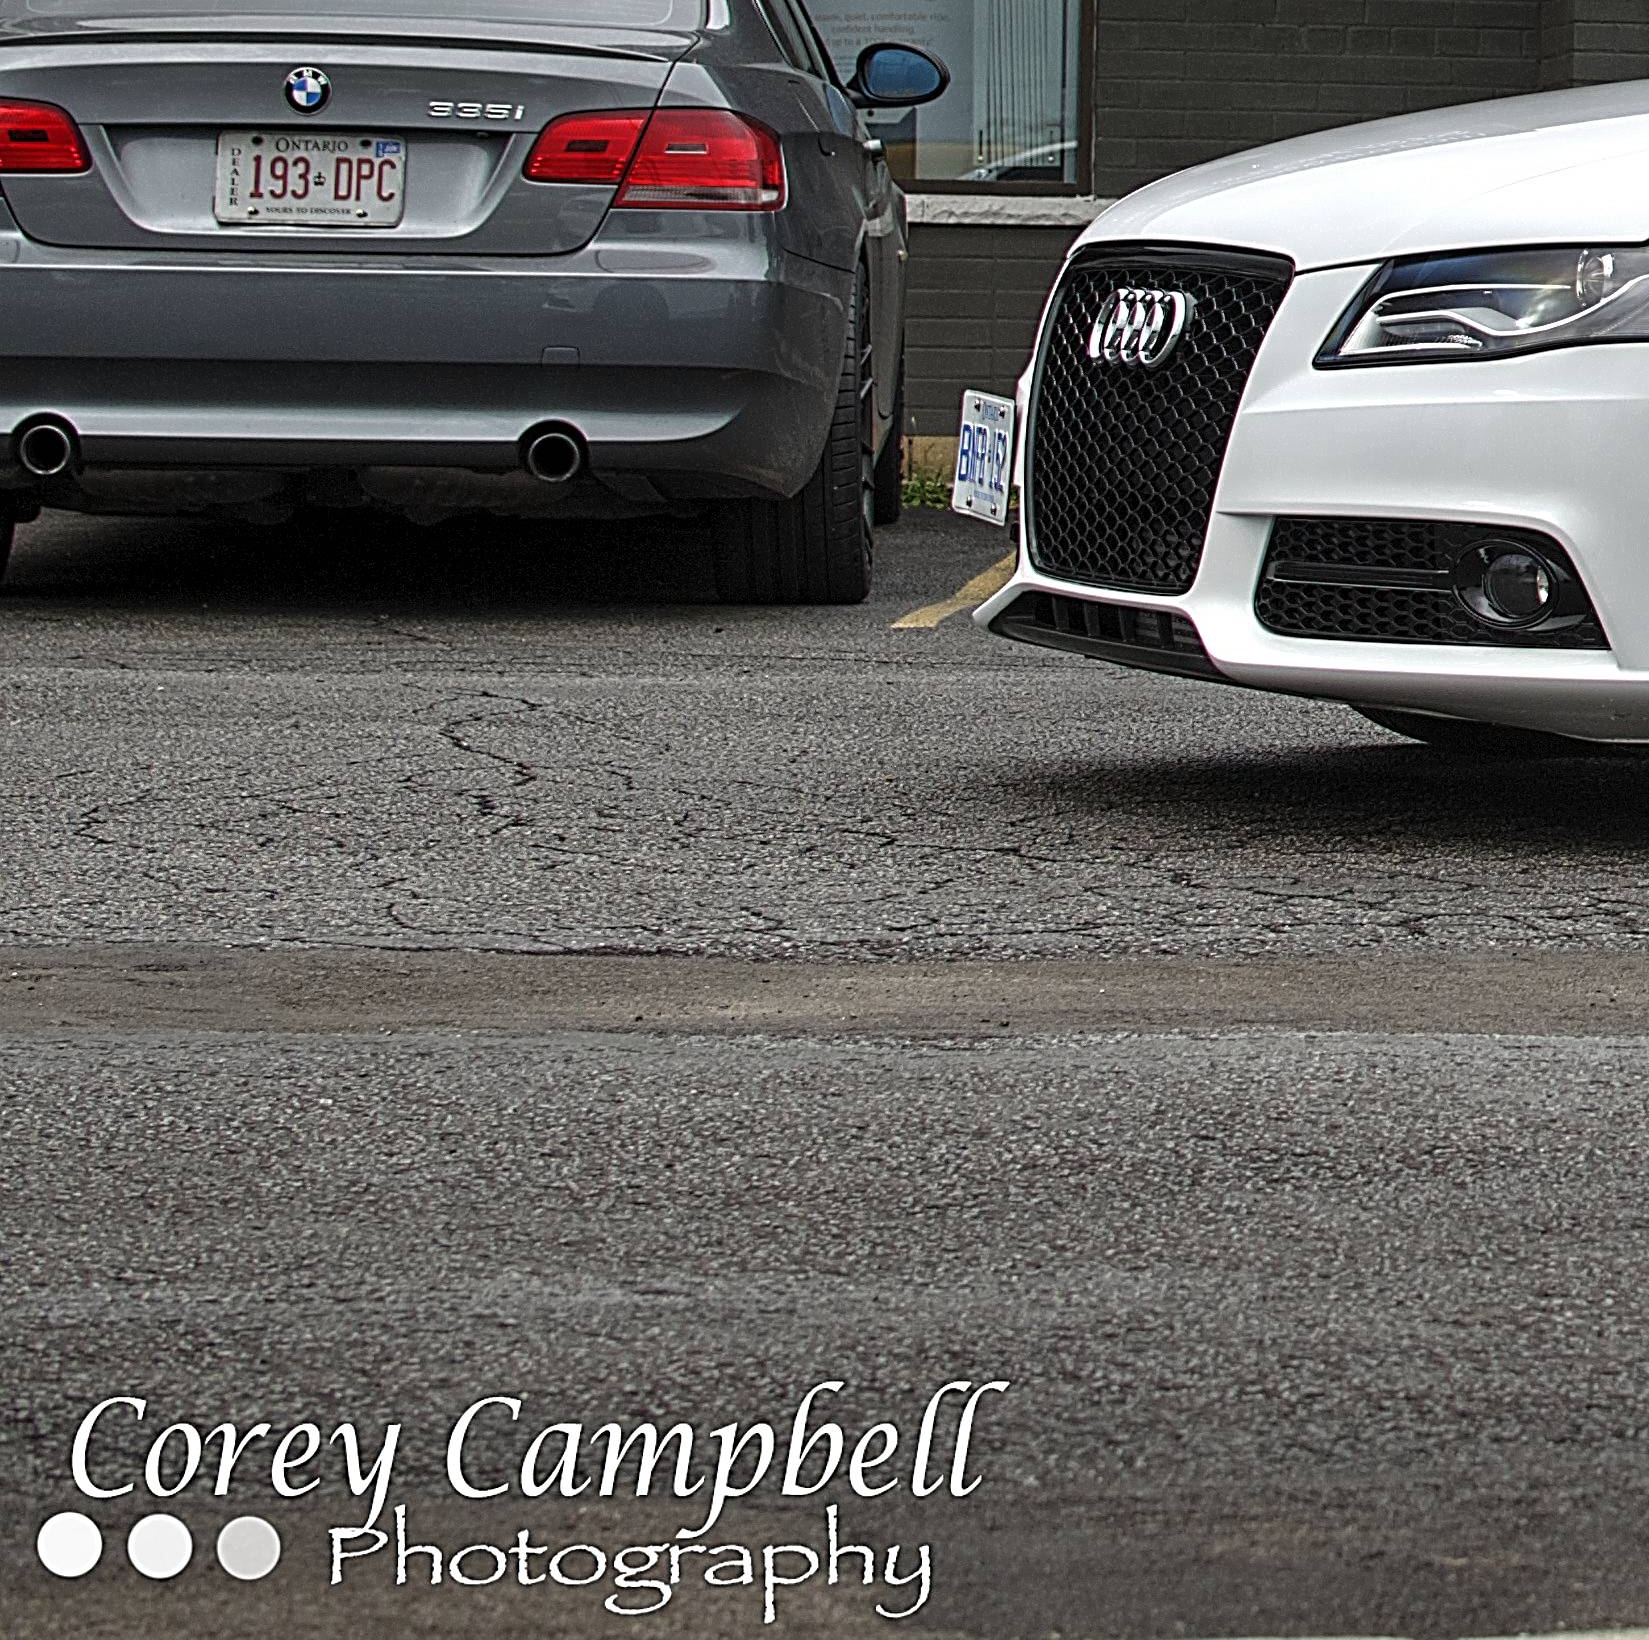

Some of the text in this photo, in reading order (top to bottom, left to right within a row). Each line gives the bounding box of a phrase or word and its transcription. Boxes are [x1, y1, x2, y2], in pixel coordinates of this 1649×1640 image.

[427, 101, 525, 120] 335i
[275, 138, 349, 153] ONTARIO
[229, 148, 242, 206] DEALER
[250, 155, 397, 202] 193 DPC
